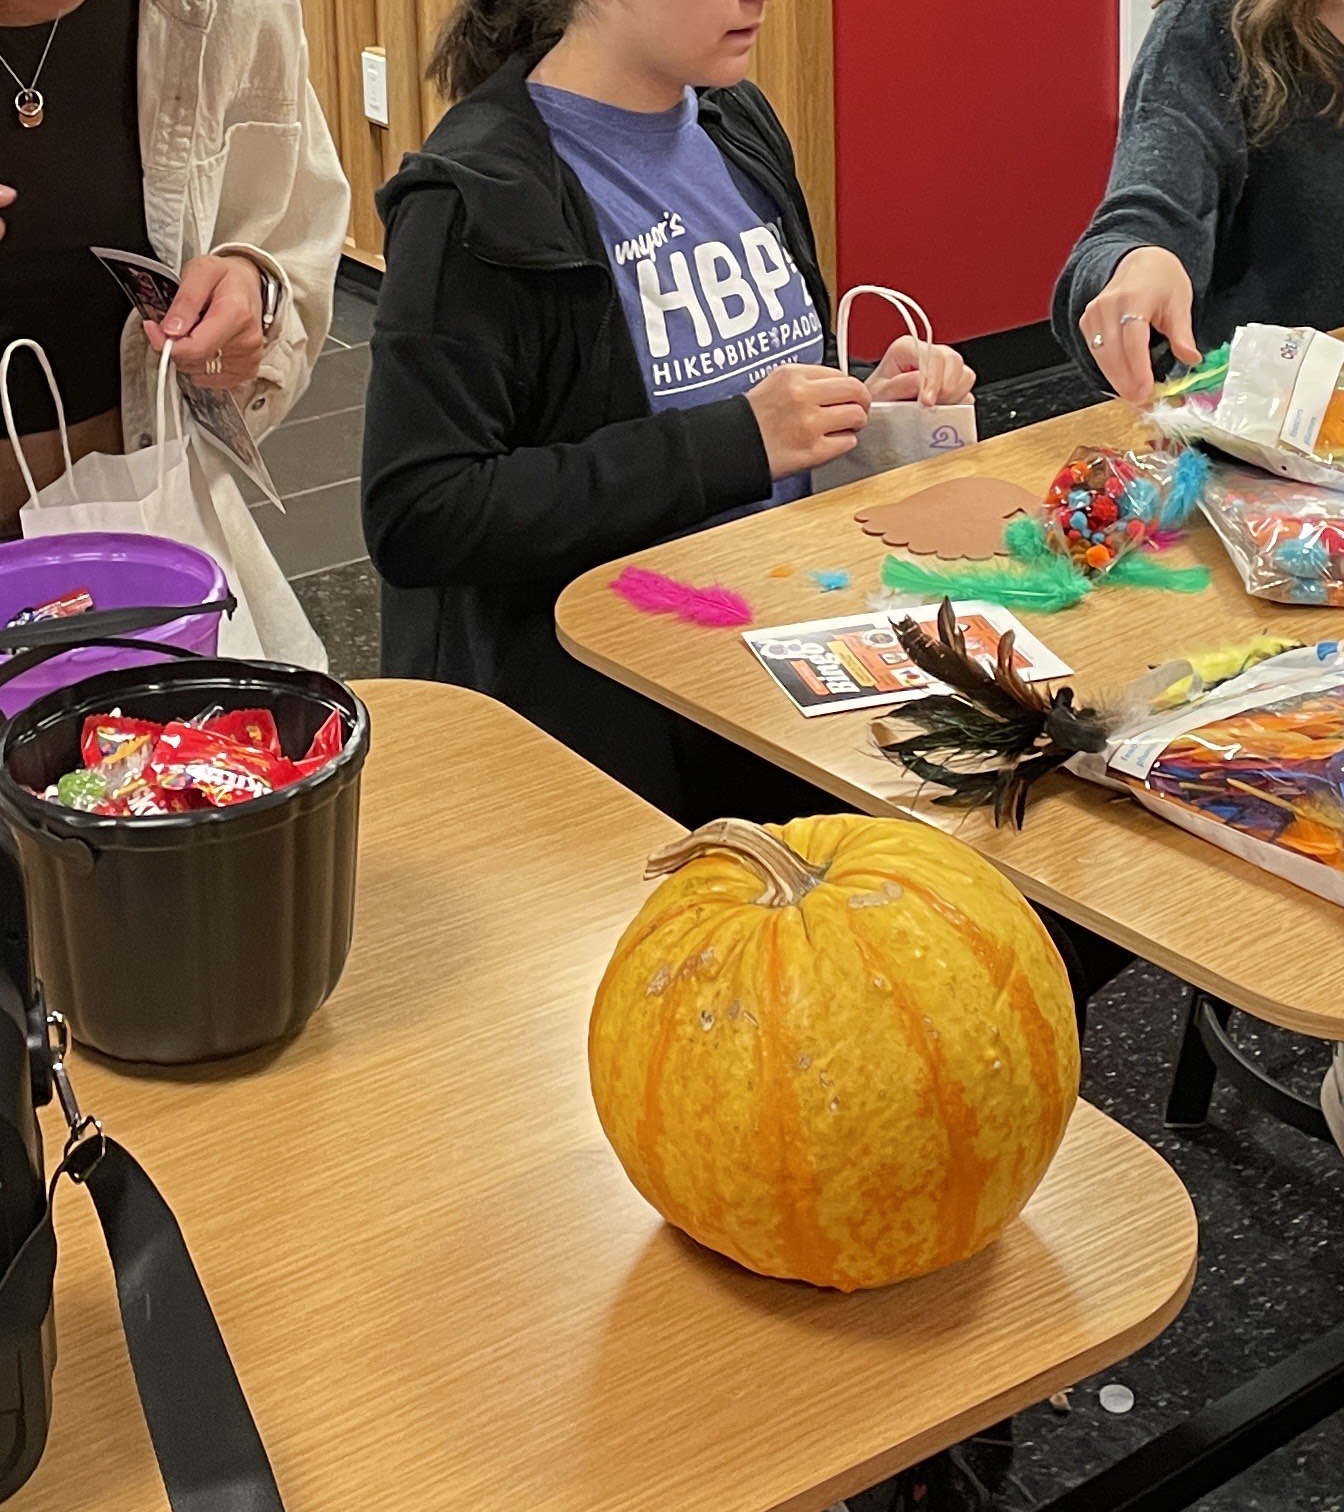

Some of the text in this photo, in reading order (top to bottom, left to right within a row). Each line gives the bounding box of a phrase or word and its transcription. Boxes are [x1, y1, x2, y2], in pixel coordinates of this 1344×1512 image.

[652, 311, 823, 386] HIKE BIKE PADD
[800, 642, 862, 695] Bingo
